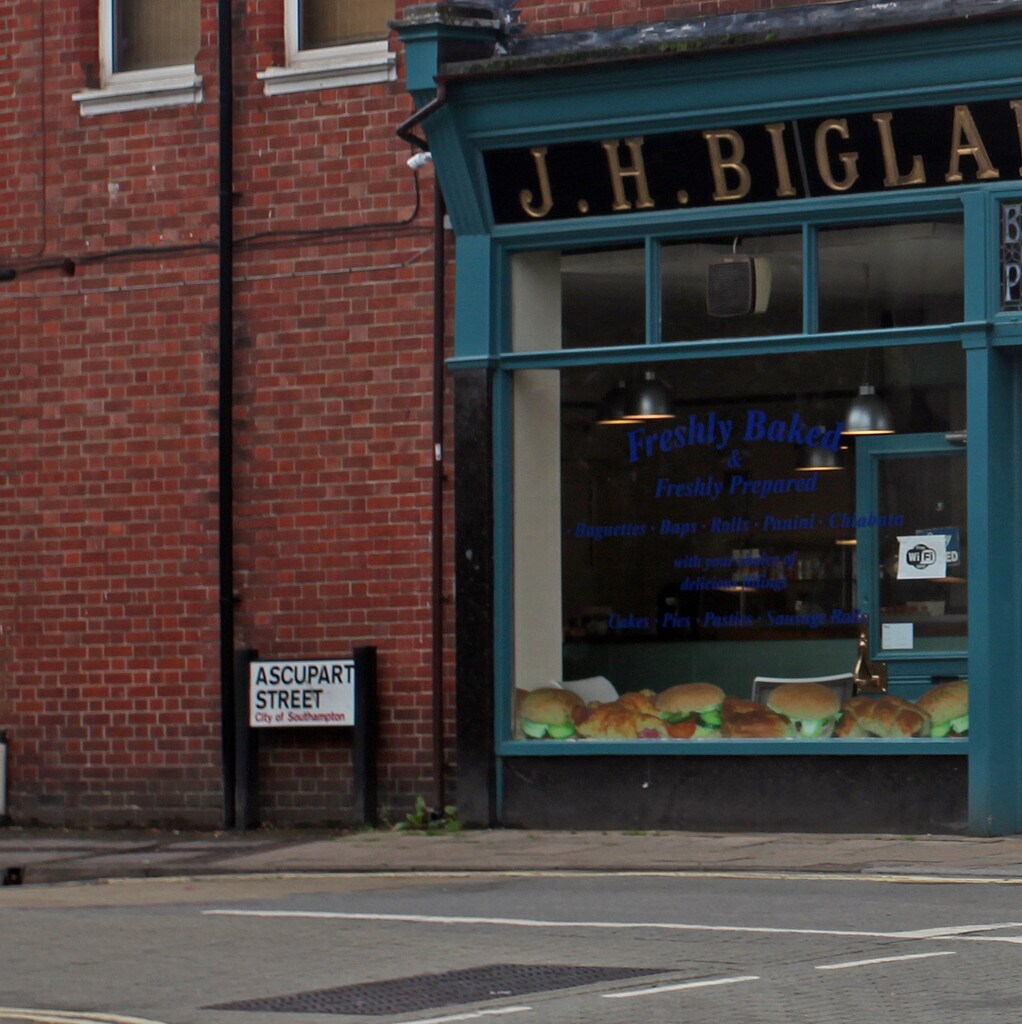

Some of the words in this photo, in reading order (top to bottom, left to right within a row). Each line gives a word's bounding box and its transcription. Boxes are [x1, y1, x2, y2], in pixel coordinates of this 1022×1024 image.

[628, 412, 734, 463] Freshly
[743, 409, 846, 453] Baked
[725, 448, 741, 469] &
[655, 475, 724, 501] Freshly
[729, 472, 820, 498] Prepared
[576, 522, 647, 541] Baguettes
[659, 518, 698, 540] Baps
[711, 516, 750, 534] Rolls
[763, 513, 816, 531] Panini
[256, 664, 355, 685] ASCUPART
[256, 689, 323, 709] STREET
[255, 712, 272, 724] City
[276, 711, 284, 722] of
[288, 711, 345, 723] Southampton
